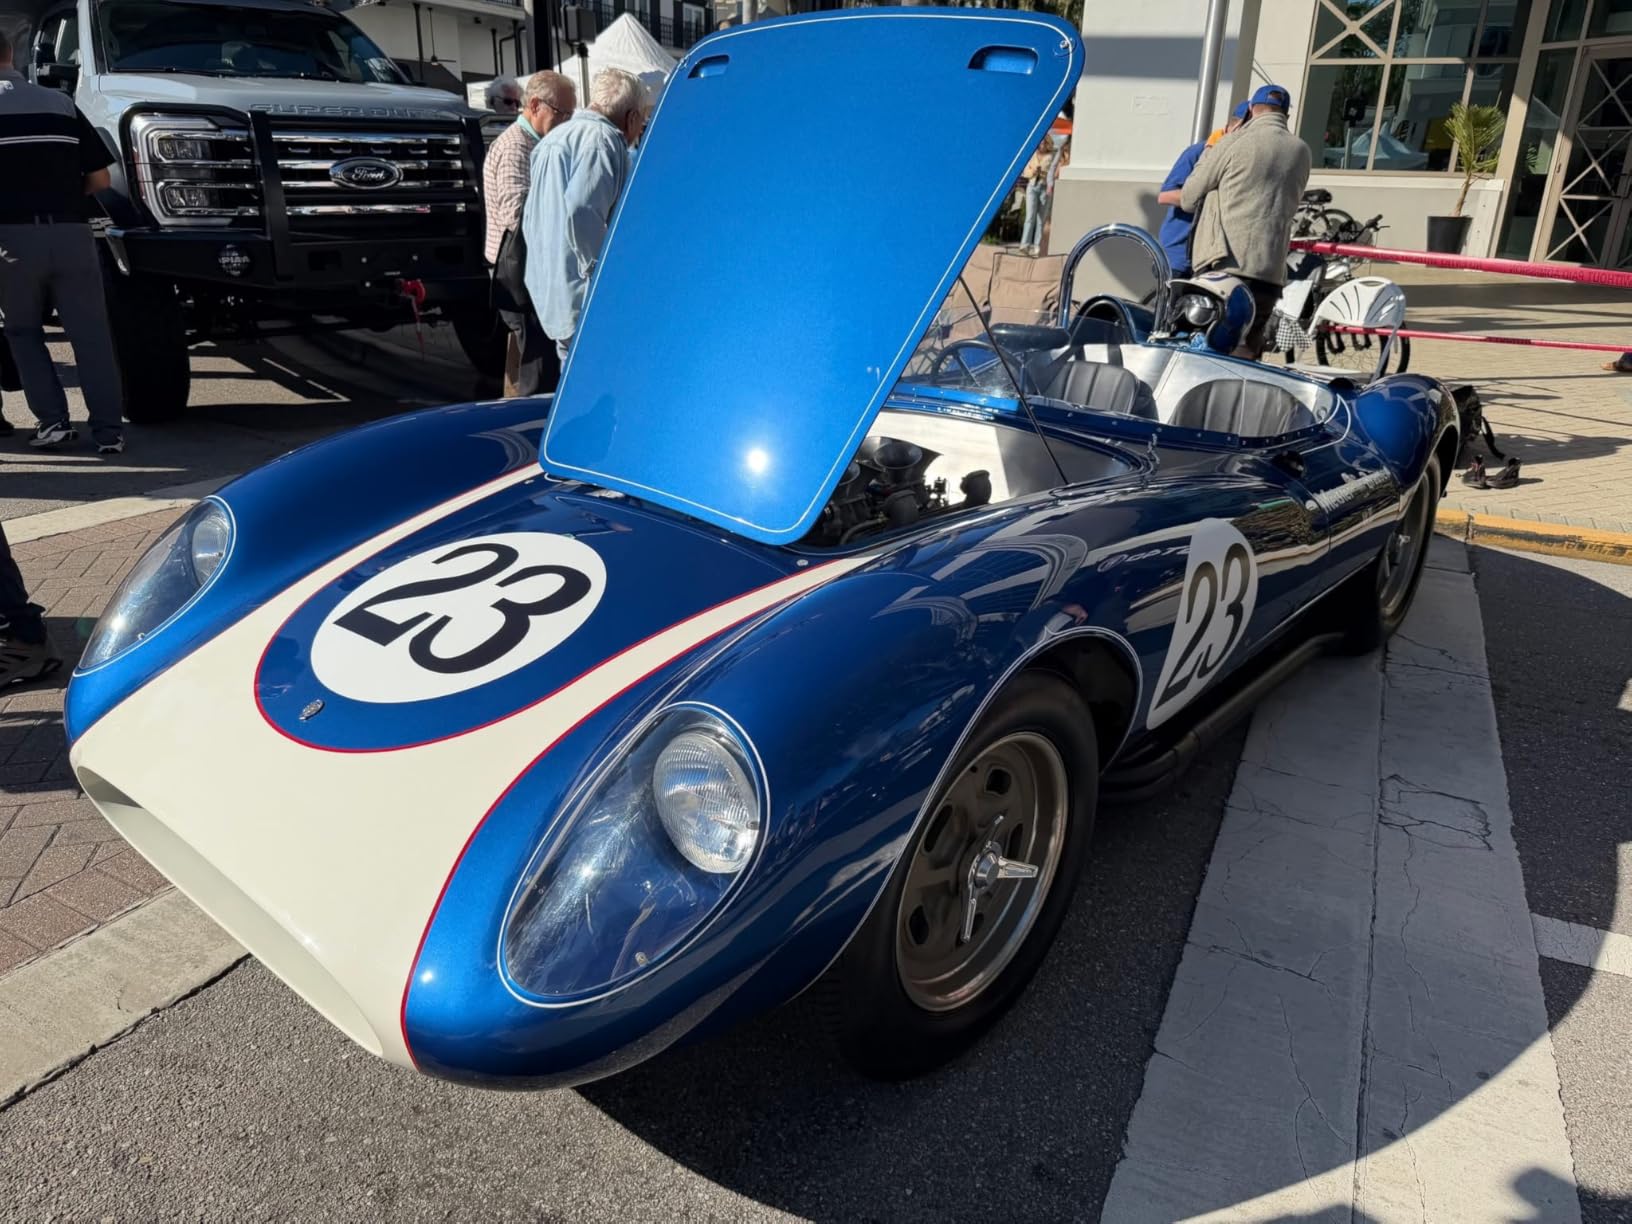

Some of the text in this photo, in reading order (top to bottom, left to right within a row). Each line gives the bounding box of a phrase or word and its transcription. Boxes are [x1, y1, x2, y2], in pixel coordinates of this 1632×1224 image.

[351, 166, 385, 181] Ford
[333, 543, 592, 674] 23
[1154, 543, 1250, 710] 23
